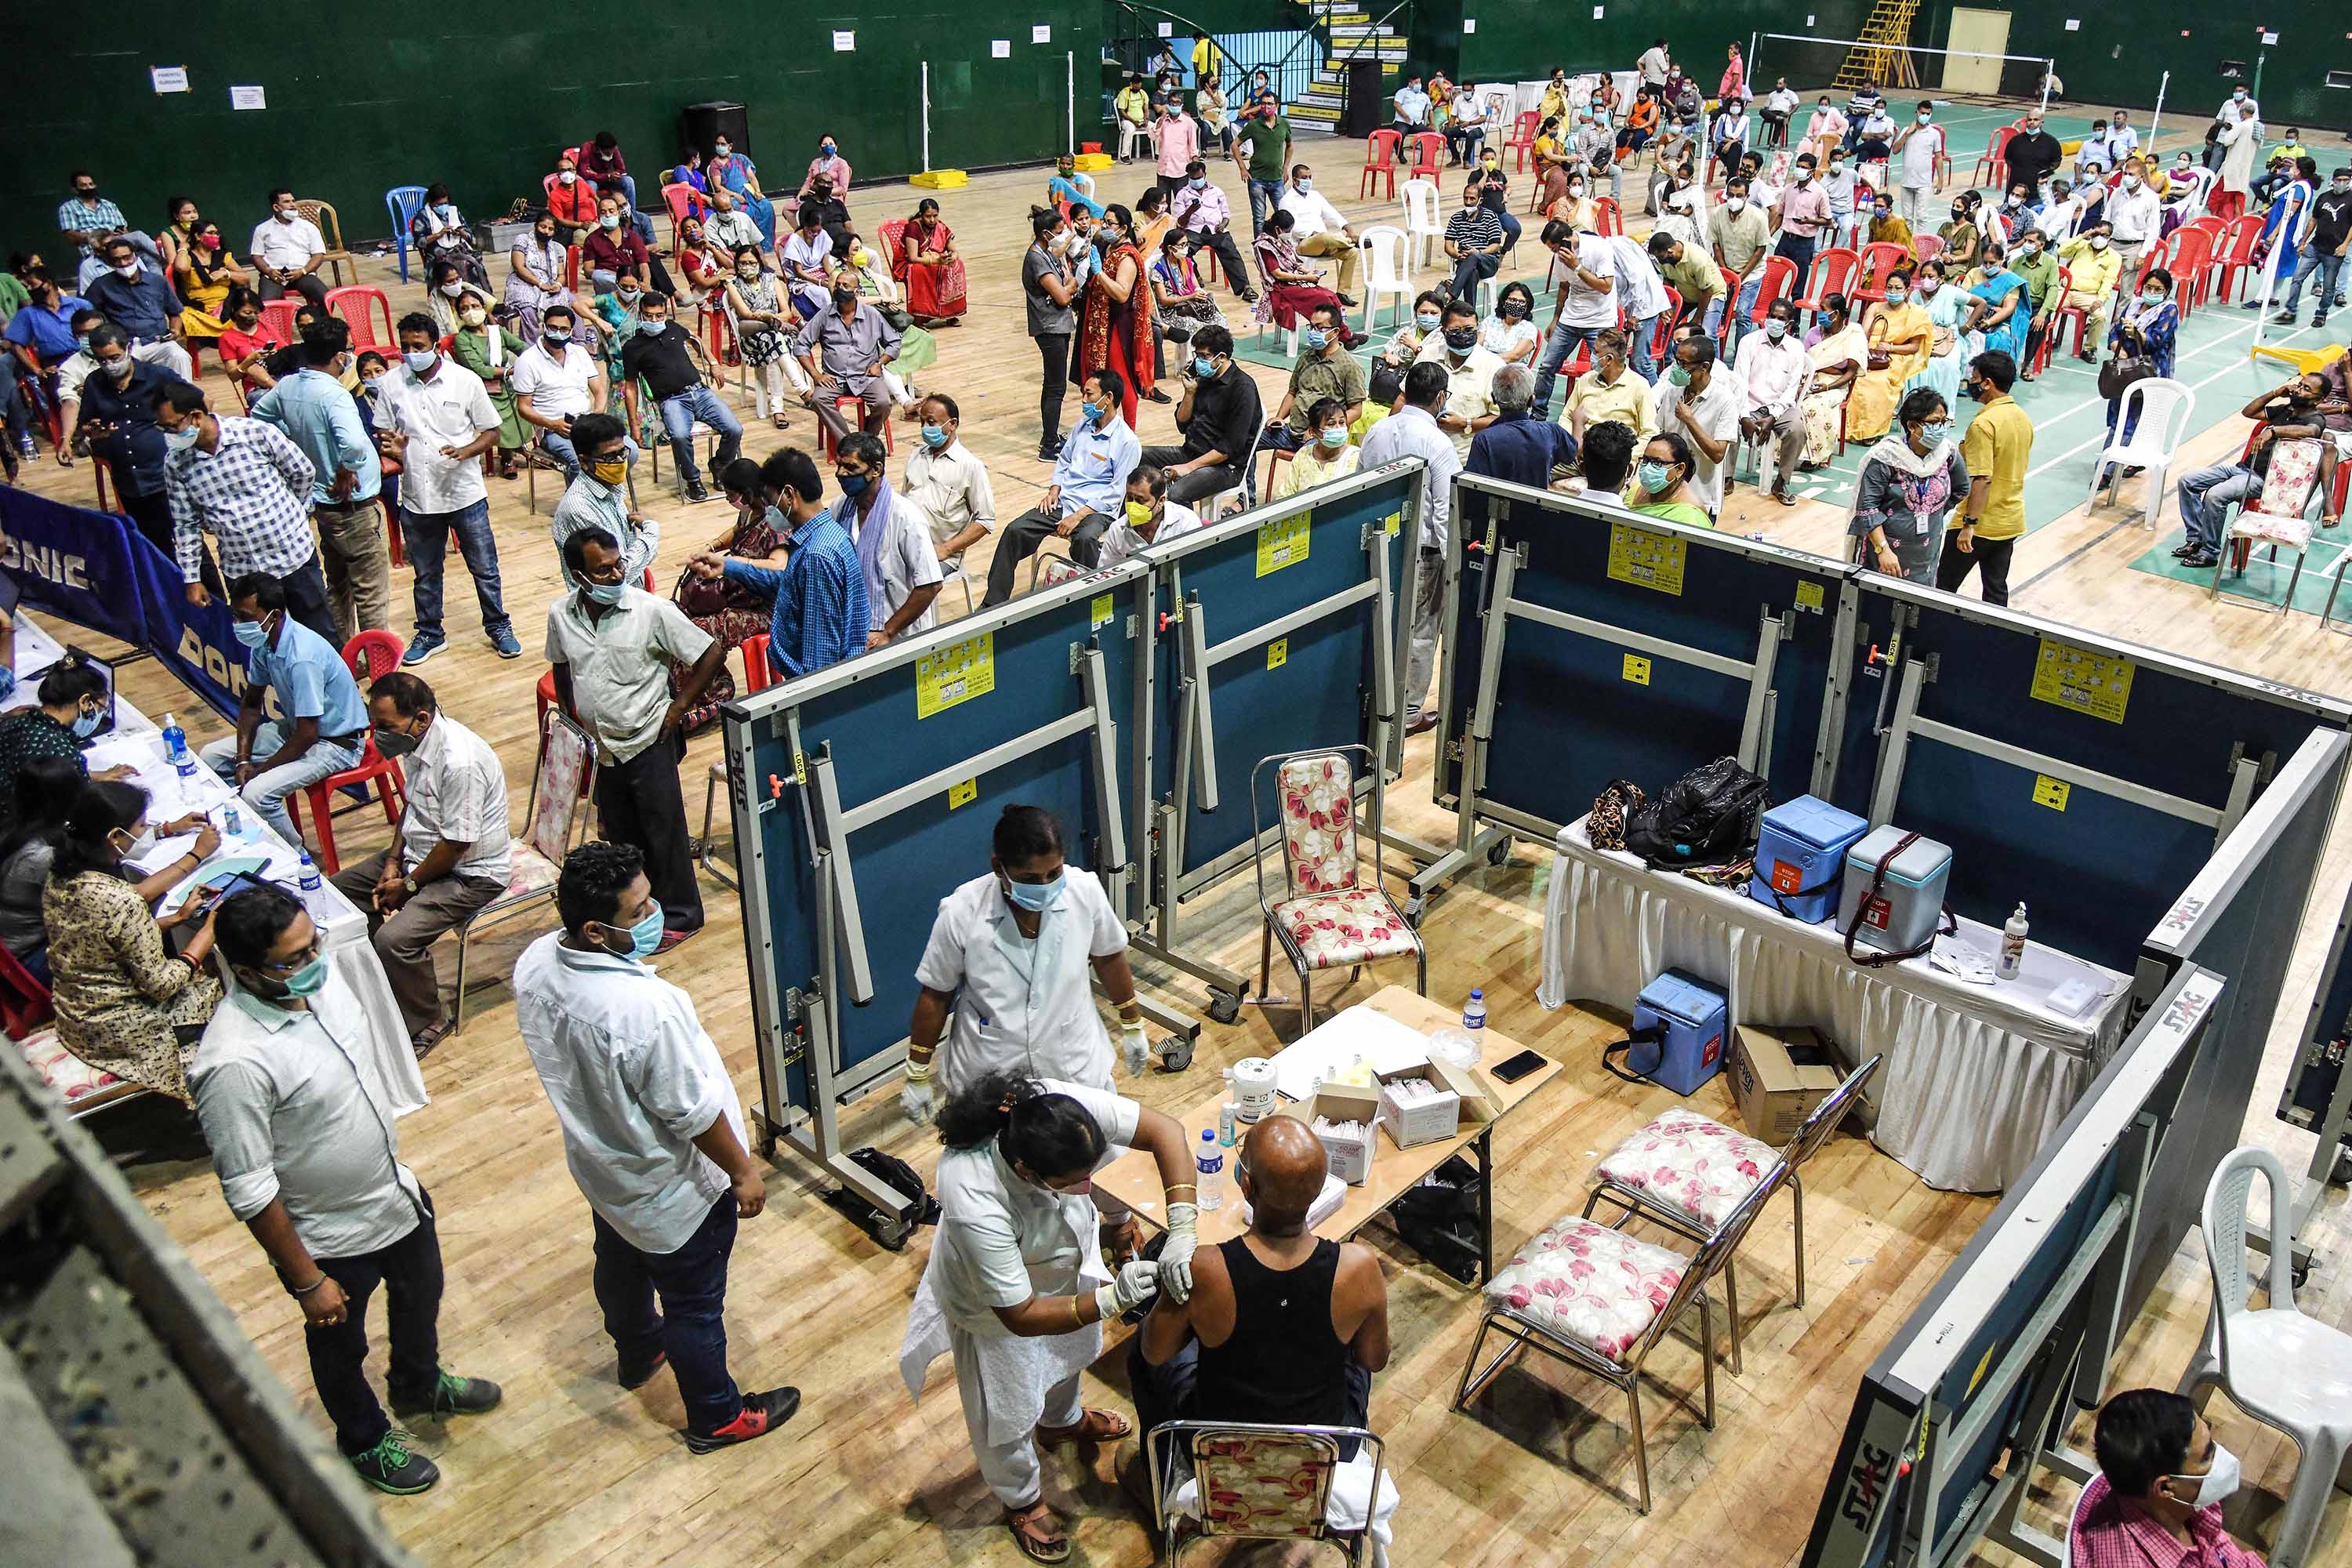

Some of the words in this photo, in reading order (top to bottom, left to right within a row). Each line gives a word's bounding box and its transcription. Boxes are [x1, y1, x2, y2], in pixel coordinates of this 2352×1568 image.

[2, 535, 89, 590] ONIC
[1081, 567, 1127, 585] STAG
[1888, 639, 1897, 658] LOCK
[177, 623, 285, 720] DONC
[795, 753, 804, 775] LOCK
[2163, 896, 2205, 931] STAG
[2163, 990, 2208, 1034] STAG
[1842, 1443, 1895, 1534] STAG
